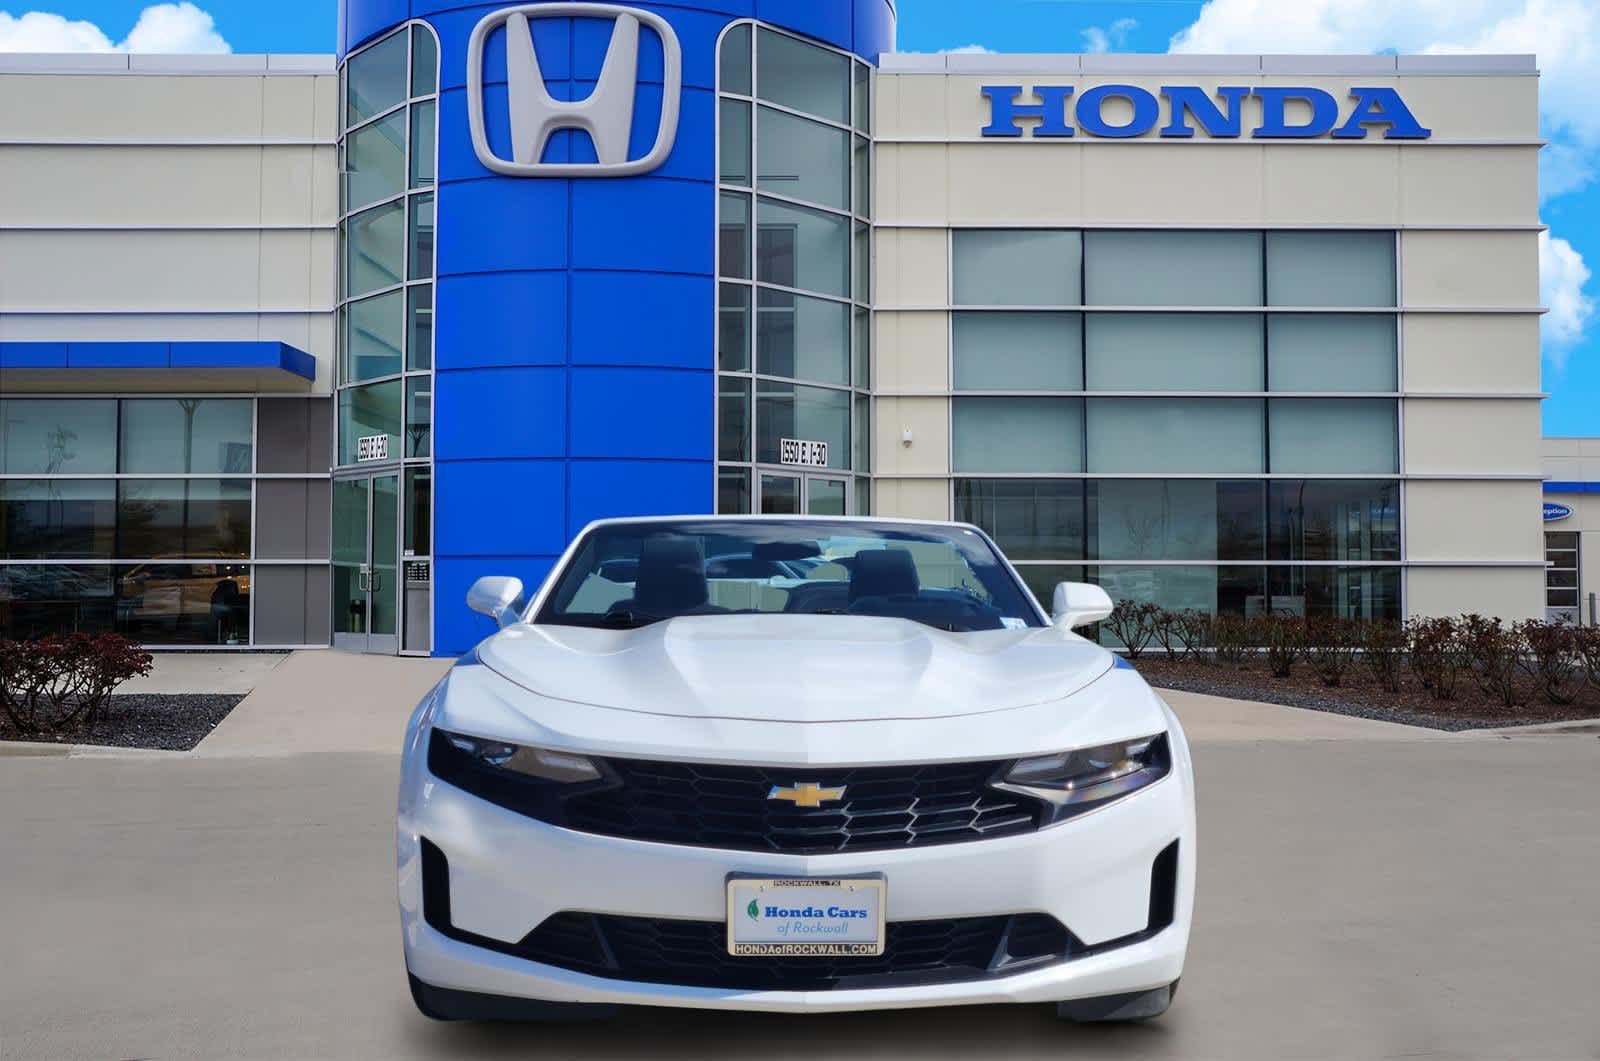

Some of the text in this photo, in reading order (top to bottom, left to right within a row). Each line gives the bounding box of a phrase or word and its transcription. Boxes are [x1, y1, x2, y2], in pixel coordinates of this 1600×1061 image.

[980, 84, 1432, 140] HONDA
[782, 439, 800, 463] 1550
[1543, 507, 1568, 516] eption
[764, 906, 868, 918] Honda Cars
[776, 921, 849, 936] of Rockwall
[735, 944, 878, 955] HONDAofROCKWALL.COM
